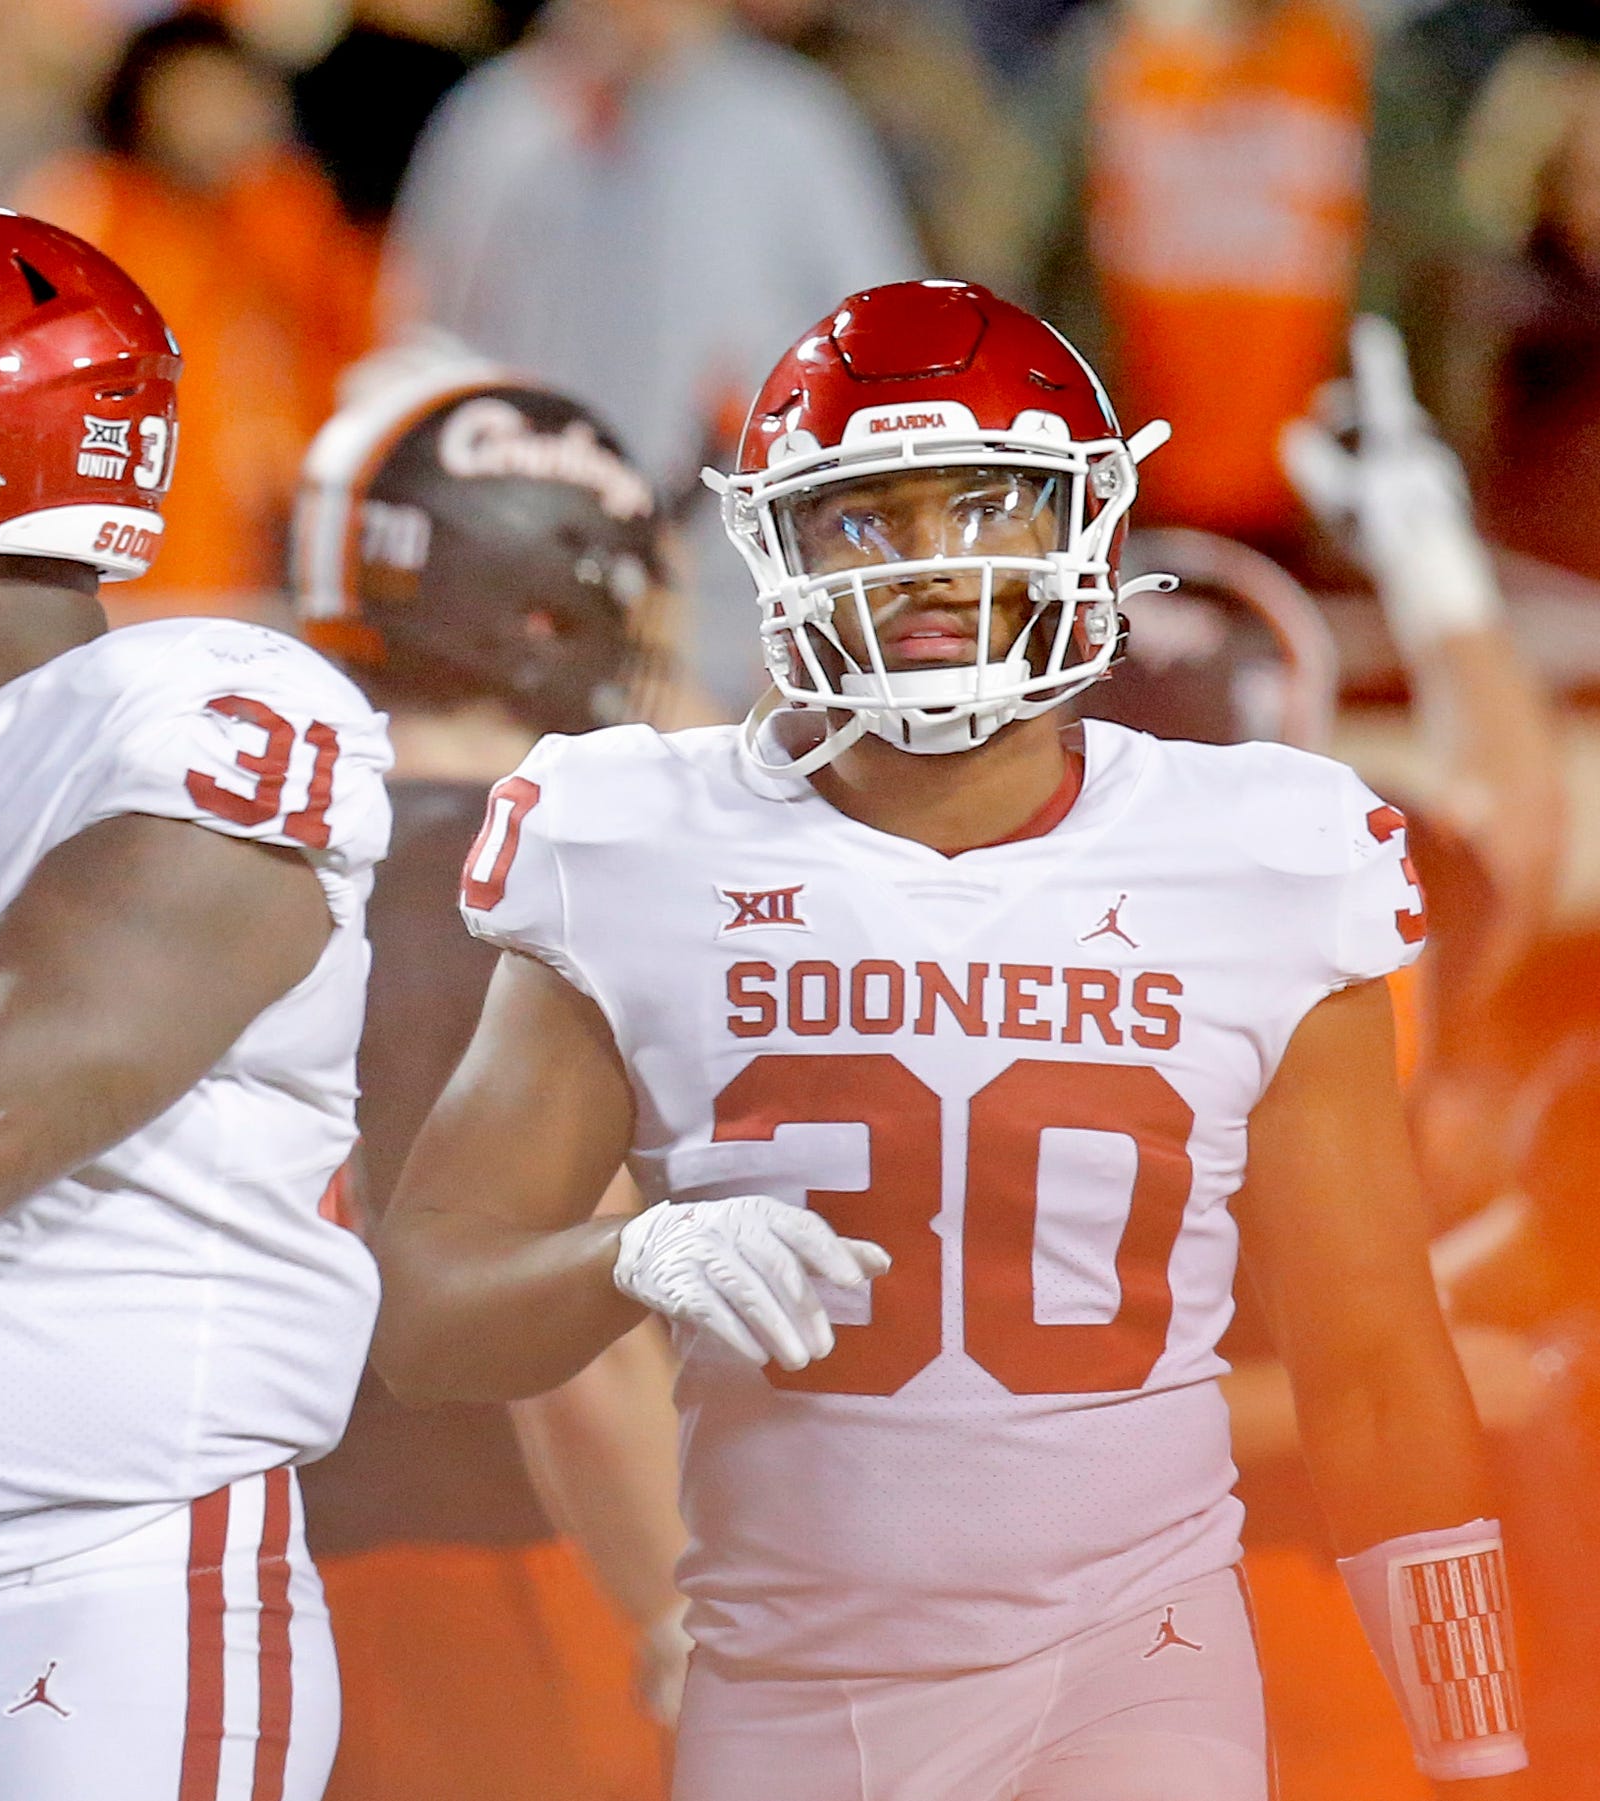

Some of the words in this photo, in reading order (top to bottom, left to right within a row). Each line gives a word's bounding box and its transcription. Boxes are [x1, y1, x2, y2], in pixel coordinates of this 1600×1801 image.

[869, 412, 946, 434] OKLAHOMA
[76, 451, 129, 481] UNITY
[184, 694, 341, 850] 31
[723, 884, 805, 930] XII
[725, 959, 1184, 1051] SOONERS
[710, 1053, 1196, 1397] 30
